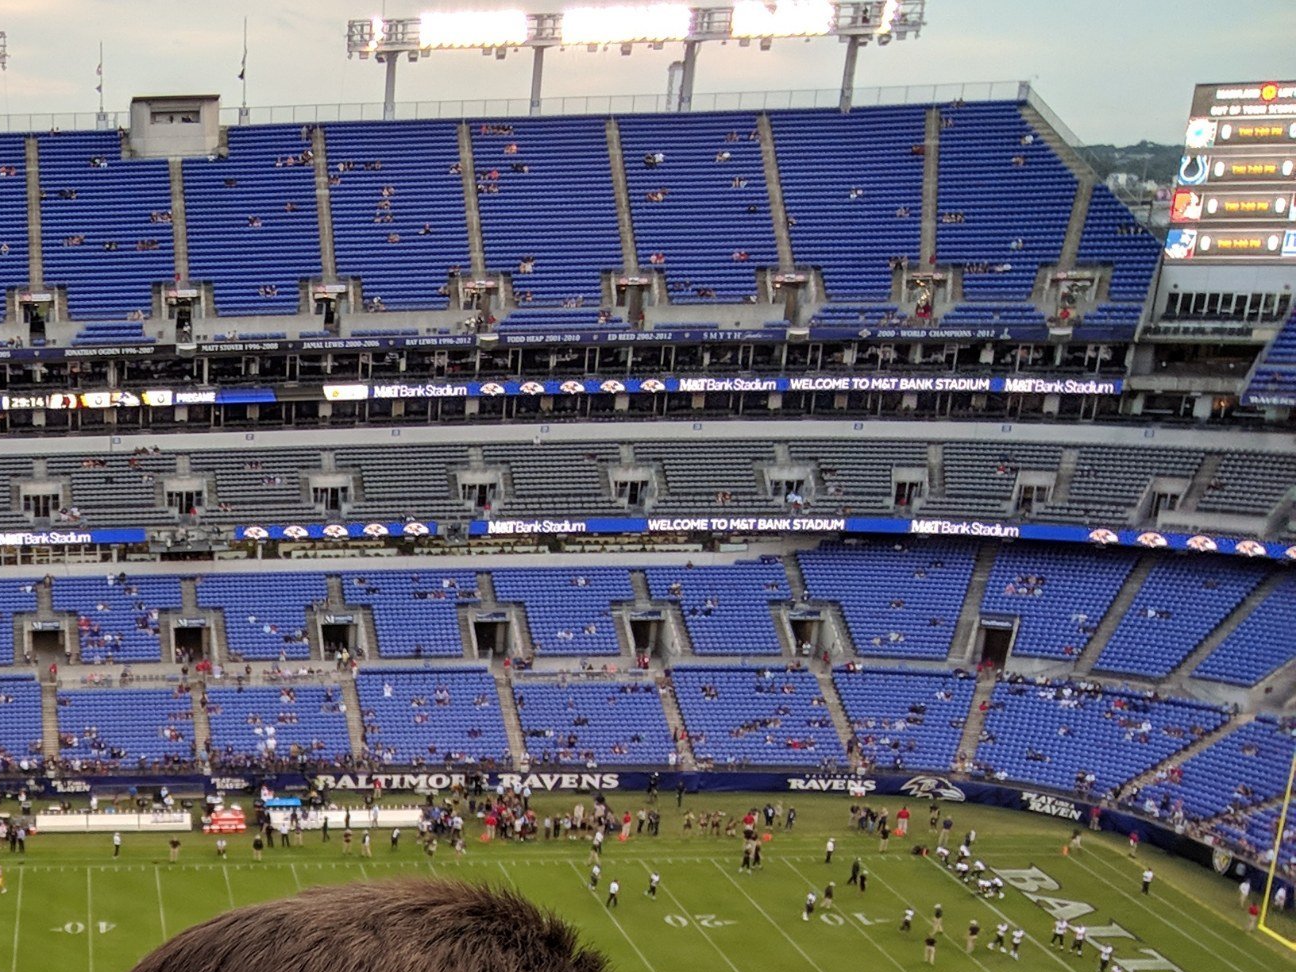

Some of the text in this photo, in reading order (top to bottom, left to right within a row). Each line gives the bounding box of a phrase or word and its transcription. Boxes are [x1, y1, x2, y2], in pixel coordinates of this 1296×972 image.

[507, 335, 525, 343] TODD
[703, 332, 741, 340] SMYTH
[900, 330, 926, 338] WORLD
[929, 330, 972, 338] CHAMPIONS
[401, 385, 426, 397] Bank
[426, 384, 467, 397] Stadium
[708, 378, 734, 391] Bank
[734, 377, 776, 391] Stadium
[790, 378, 851, 390] WELCOME
[852, 378, 870, 389] TO
[900, 378, 934, 390] BANK
[935, 378, 990, 390] STADIUM
[1035, 379, 1065, 393] Bank
[1065, 379, 1114, 394] Stadium
[516, 520, 542, 533] Bank
[542, 520, 586, 532] Stadium
[648, 518, 708, 531] WELCOME
[711, 518, 728, 530] TO
[758, 519, 791, 530] BANK
[792, 519, 845, 530] STADIUM
[942, 521, 971, 535] Bank
[971, 521, 1019, 537] Stadium
[25, 533, 50, 544] Bank
[50, 531, 91, 544] Stadium
[498, 773, 619, 790] RAVENS
[787, 777, 877, 792] RAVENS
[1028, 800, 1083, 821] RAVEN
